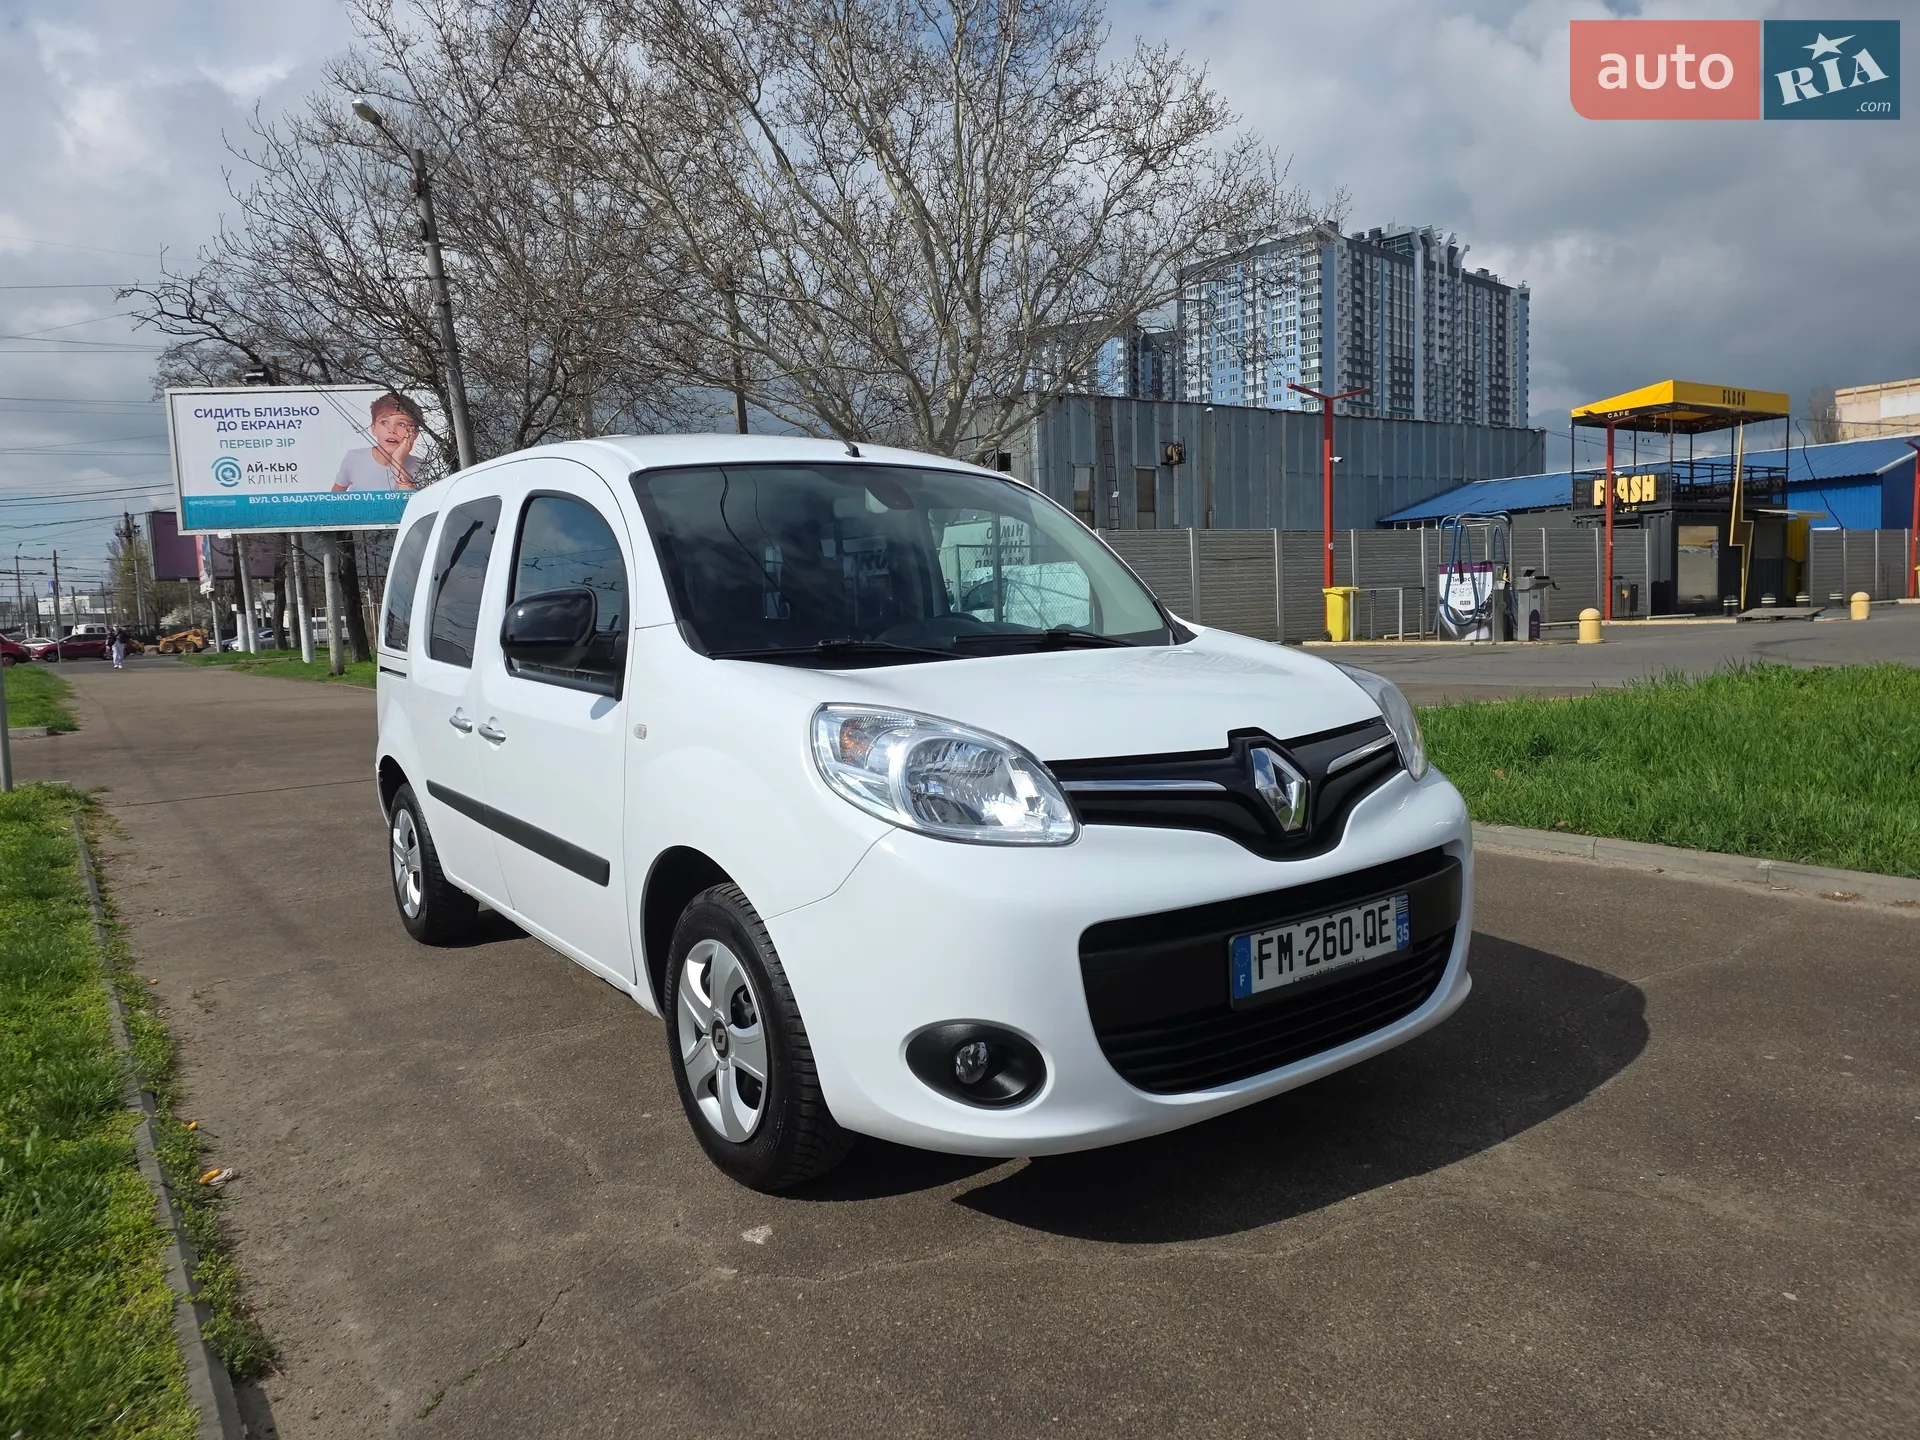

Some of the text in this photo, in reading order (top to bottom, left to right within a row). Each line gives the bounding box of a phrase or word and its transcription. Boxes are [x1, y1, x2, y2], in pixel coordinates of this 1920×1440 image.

[194, 406, 320, 420] СИДИТЬ БЛИЗЬКО
[1607, 410, 1630, 419] CAFE
[216, 419, 302, 432] ДО ЕКРАНА?
[219, 438, 296, 449] ПЕРЕВІР ЗІР
[246, 461, 298, 473] АЙ-КЬЮ
[247, 474, 299, 485] КЛІНІК
[1593, 474, 1657, 506] FASH
[249, 496, 270, 504] ВУЛ.
[282, 493, 361, 504] ВАДАТУРСЬКОГО
[384, 492, 401, 500] 097
[986, 523, 1025, 540] ОМІН
[974, 555, 1026, 569] ПРАЖ
[1396, 923, 1410, 943] 35
[1239, 974, 1246, 987] F
